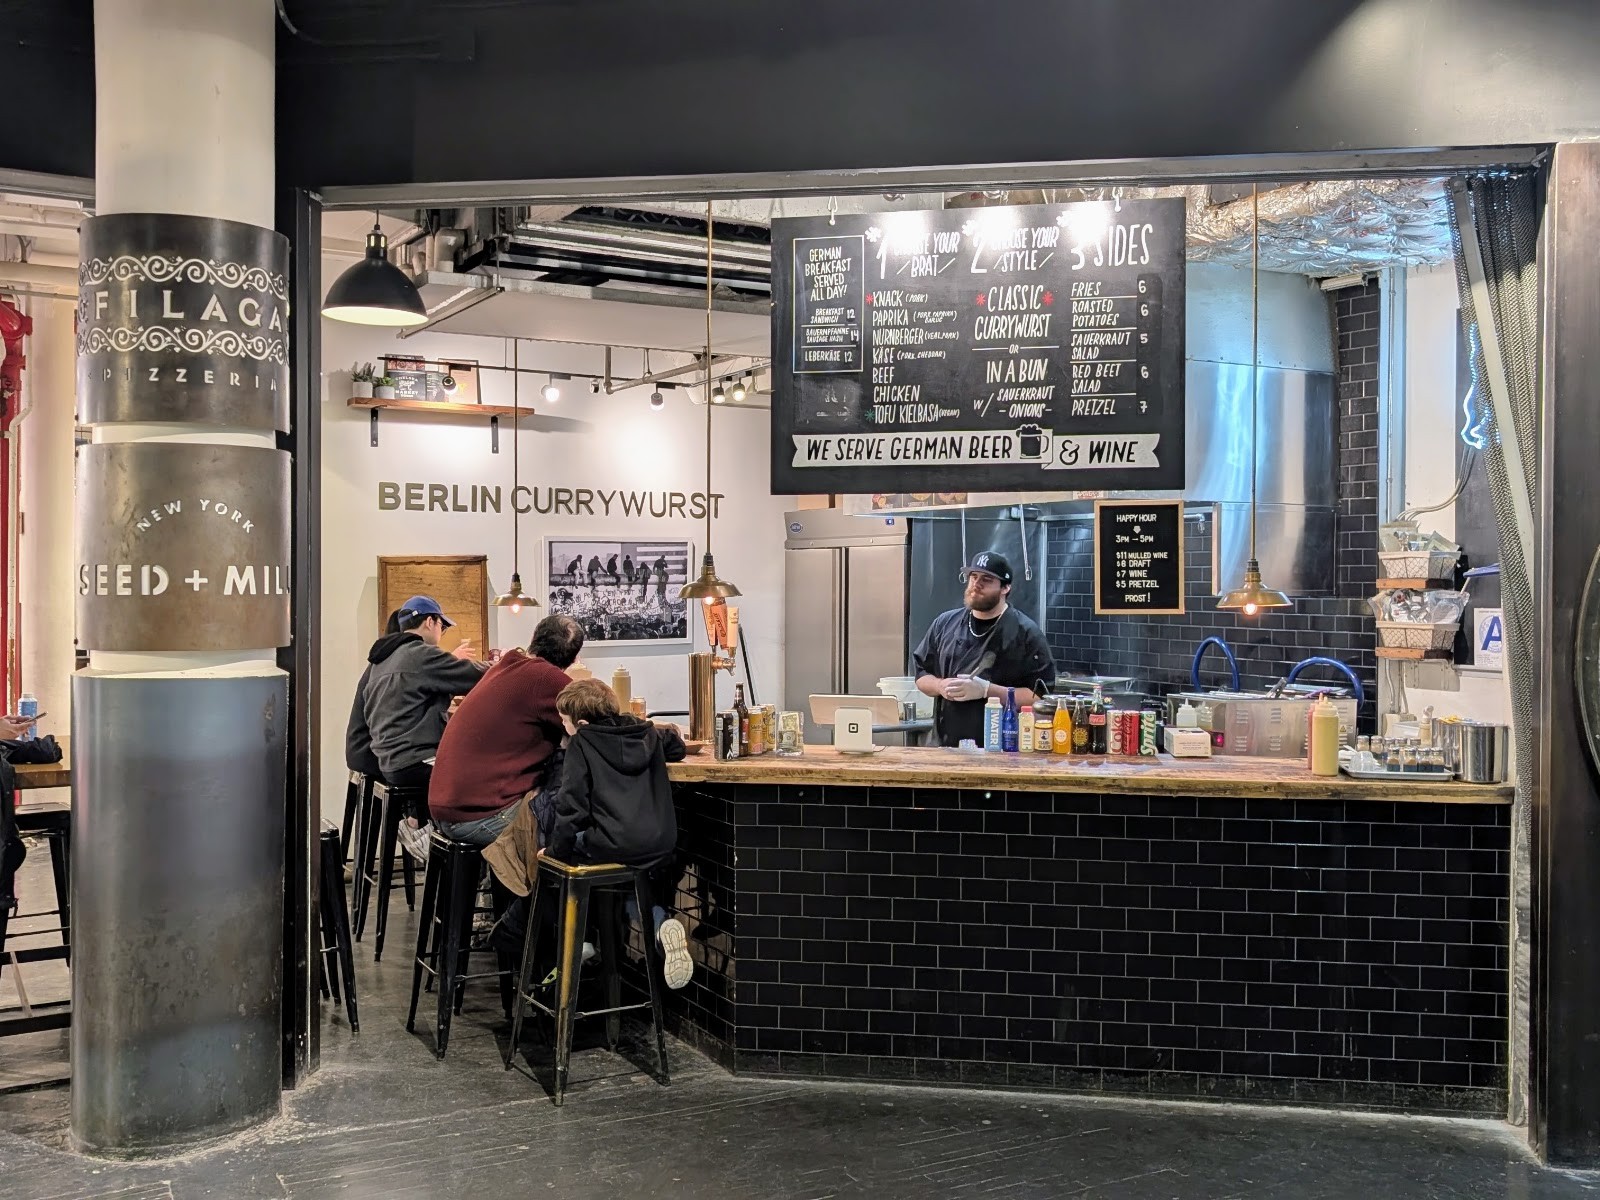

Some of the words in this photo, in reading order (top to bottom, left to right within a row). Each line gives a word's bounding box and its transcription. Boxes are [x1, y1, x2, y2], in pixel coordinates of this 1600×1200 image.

[933, 231, 961, 254] YOUR
[1031, 226, 1060, 249] YOUR
[809, 246, 842, 263] GERMAN
[1001, 250, 1038, 273] STYLE
[804, 258, 852, 277] BREAKFAST
[910, 255, 939, 278] BRAT
[813, 273, 845, 289] SERVED
[1070, 281, 1102, 297] FRIES
[1138, 280, 1147, 294] 6
[810, 287, 825, 302] ALL
[826, 284, 848, 300] DAY!
[872, 289, 904, 307] KNACK
[905, 293, 928, 303] (PORK)
[987, 284, 1044, 313] CLASSIC
[94, 289, 283, 333] FILAGA
[815, 307, 845, 316] BREAKFAST
[846, 308, 856, 319] 12
[1071, 298, 1114, 314] ROASTED
[1140, 304, 1149, 317] 6
[872, 308, 909, 327] PAPRIKA
[974, 312, 1052, 341] CURRYWURST
[1072, 313, 1120, 328] POTATOES
[850, 329, 860, 342] 14
[1070, 331, 1132, 347] SAUERKRAUT
[1140, 333, 1149, 344] 5
[804, 350, 841, 362] LEBERKÄSE
[844, 351, 853, 363] 12
[872, 346, 895, 365] KÄSE
[1008, 343, 1020, 355] OR
[1071, 346, 1100, 360] SALAD
[102, 367, 277, 391] PIZZERIA
[872, 366, 895, 384] BEEF
[986, 360, 1003, 384] IN
[1004, 359, 1016, 384] A
[1018, 357, 1049, 383] BUN
[1072, 364, 1091, 379] RED
[1095, 363, 1122, 378] BEET
[1140, 365, 1149, 379] 6
[873, 384, 921, 403] CHICKEN
[996, 385, 1056, 402] SAUERKRAUT
[1071, 379, 1101, 394] SALAD
[873, 404, 897, 424] TOFU
[899, 403, 939, 424] KIELBASA
[1008, 402, 1046, 419] ONIONS
[1071, 398, 1117, 417] PRETZEL
[1139, 400, 1148, 414] 7
[807, 439, 832, 461] WE
[834, 437, 885, 461] SERVE
[890, 436, 963, 460] GERMAN
[968, 435, 1013, 459] BEER
[1059, 439, 1080, 466] &
[1088, 440, 1139, 464] WINE
[378, 481, 502, 514] BERLIN
[509, 486, 725, 519] CURRYWURST
[136, 500, 182, 532] NEW
[199, 499, 255, 534] YORK
[1116, 515, 1138, 523] HAPPY
[1138, 514, 1157, 522] HOUR
[1115, 534, 1130, 543] 3PM
[1139, 534, 1154, 543] 5PM
[1115, 551, 1127, 560] $11
[1128, 551, 1151, 559] MULLED
[1152, 551, 1168, 559] WINE
[1128, 560, 1152, 568] DRAFT
[79, 564, 170, 596] SEED
[1116, 570, 1126, 578] $7
[1128, 570, 1148, 578] WINE
[1115, 580, 1127, 588] $5
[1128, 580, 1160, 588] PRETZEL
[1480, 616, 1502, 651] A
[1109, 714, 1122, 754] Coke
[1140, 713, 1158, 756] Sprite
